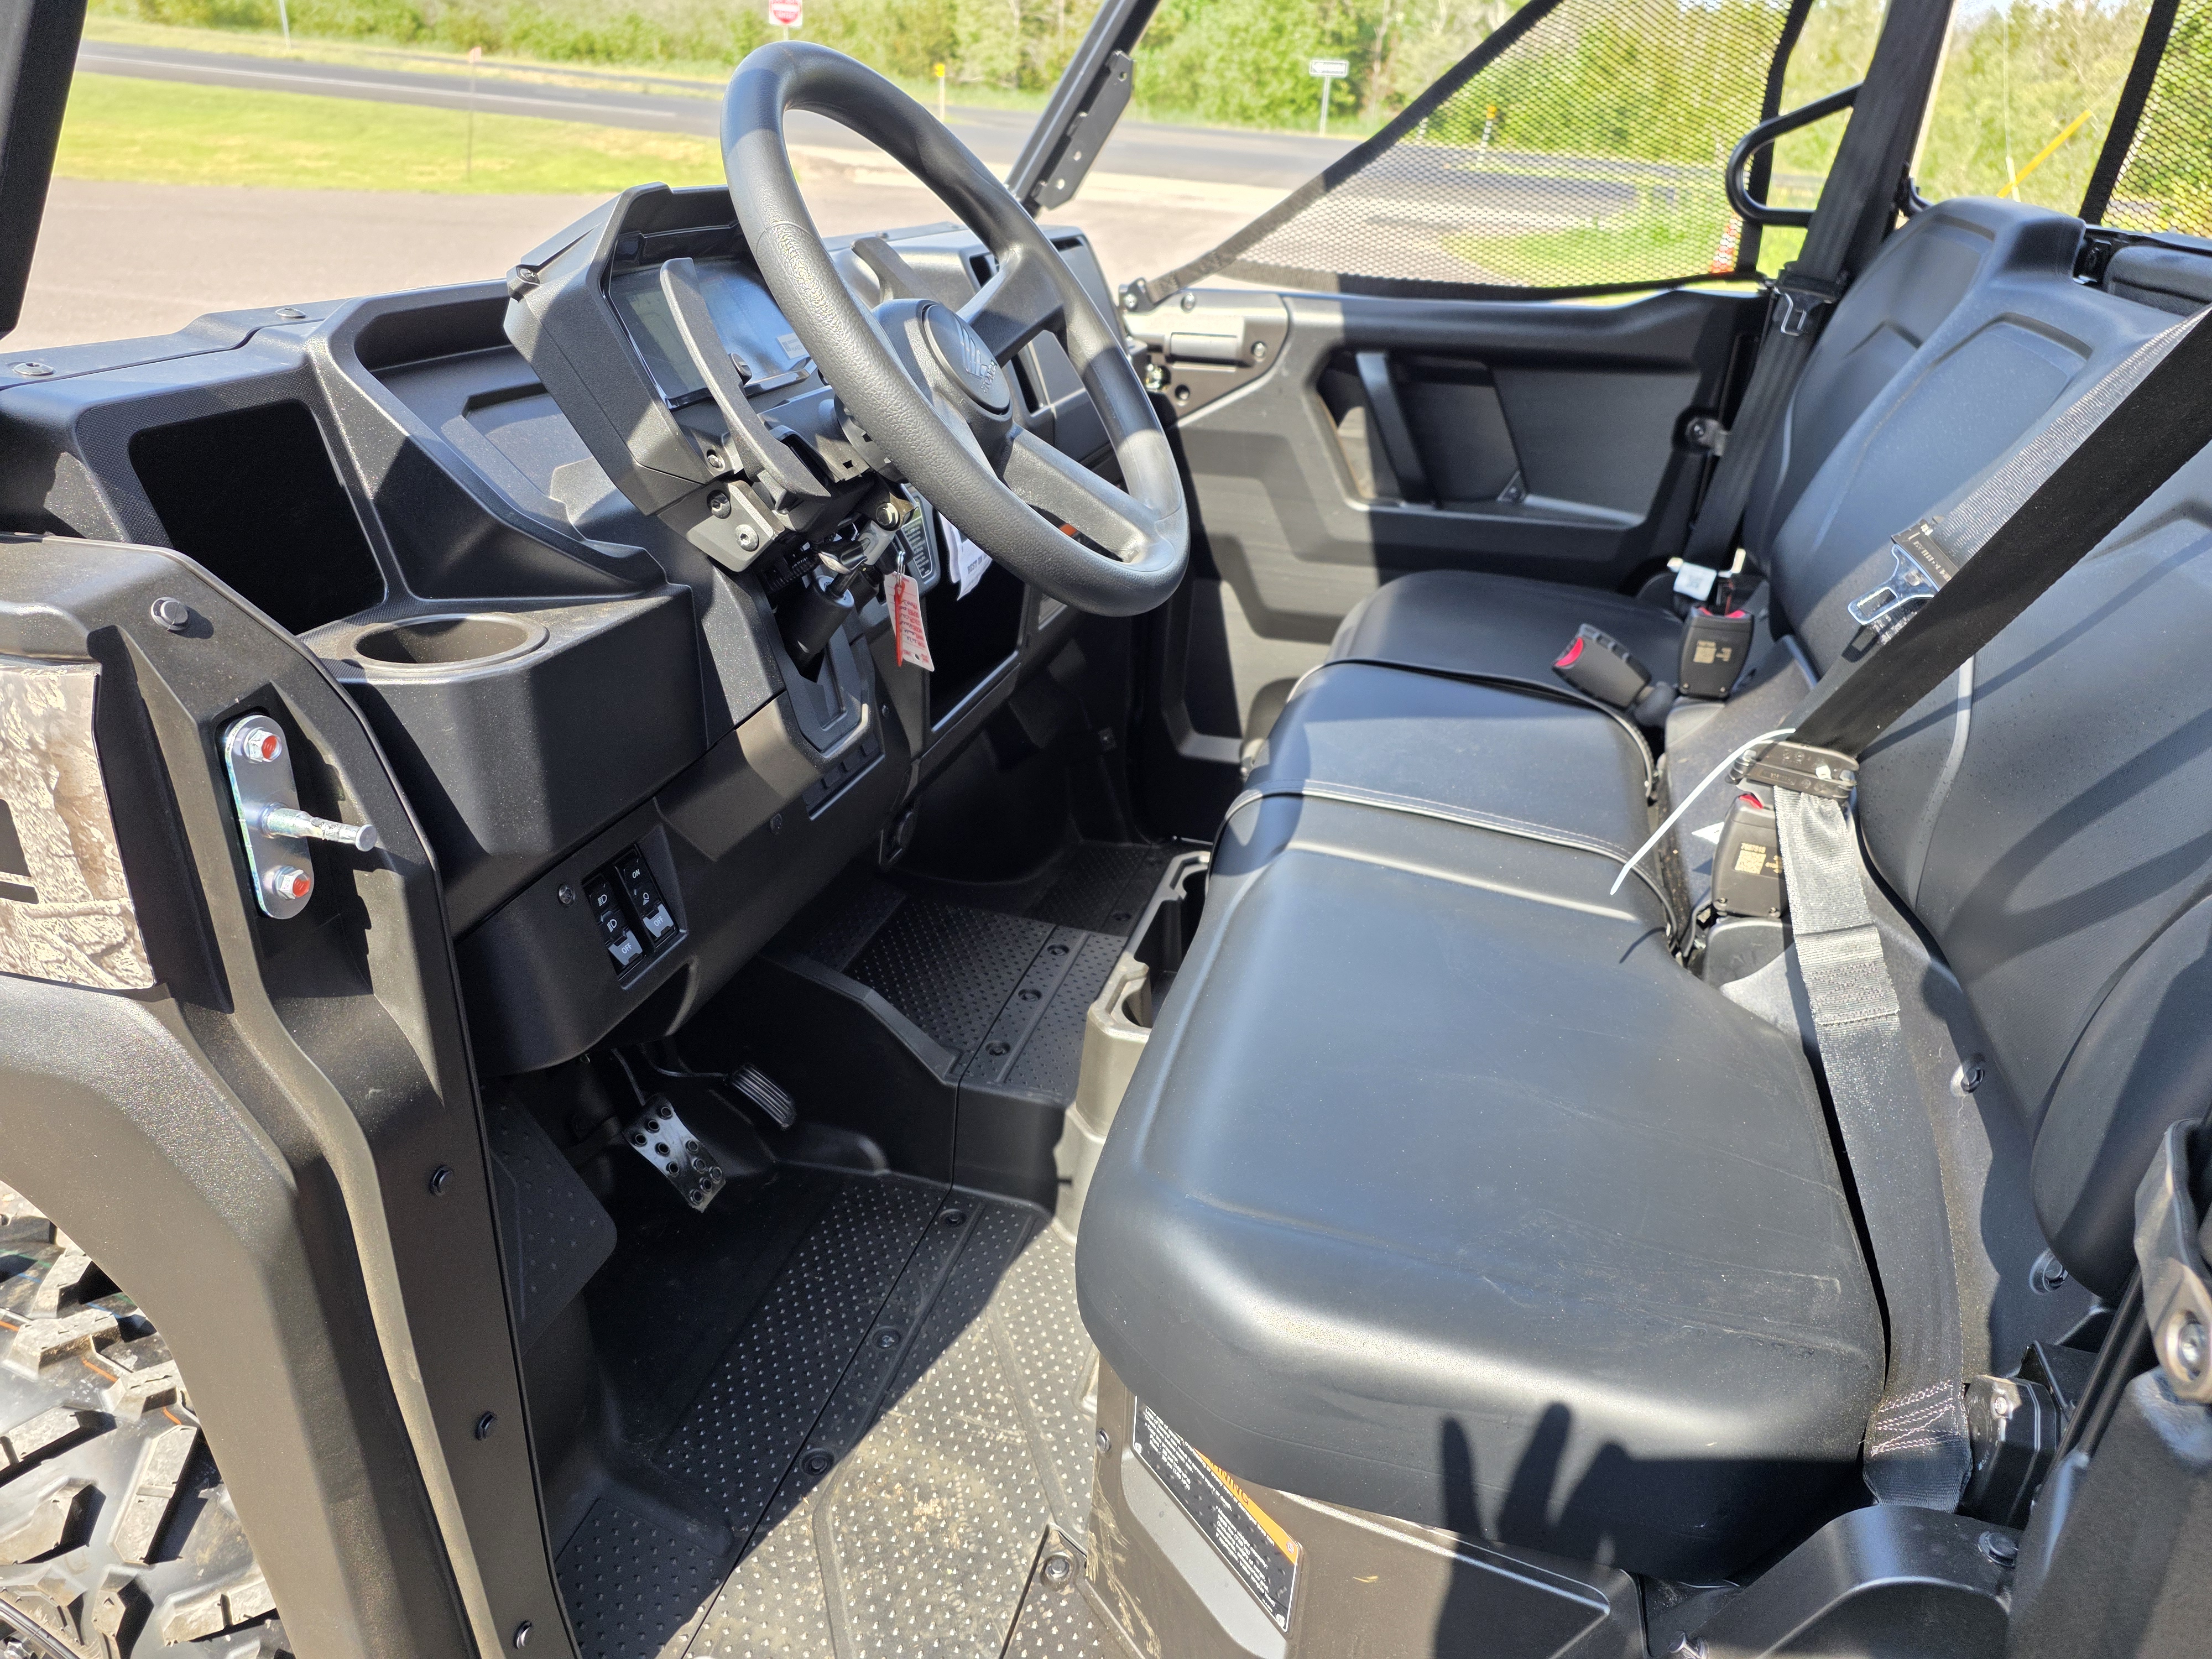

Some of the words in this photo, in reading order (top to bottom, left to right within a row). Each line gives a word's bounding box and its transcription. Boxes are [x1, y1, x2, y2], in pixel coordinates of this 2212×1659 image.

[980, 359, 998, 394] HONDA
[632, 869, 640, 879] ON
[654, 916, 664, 927] OFF
[621, 942, 632, 954] OFF
